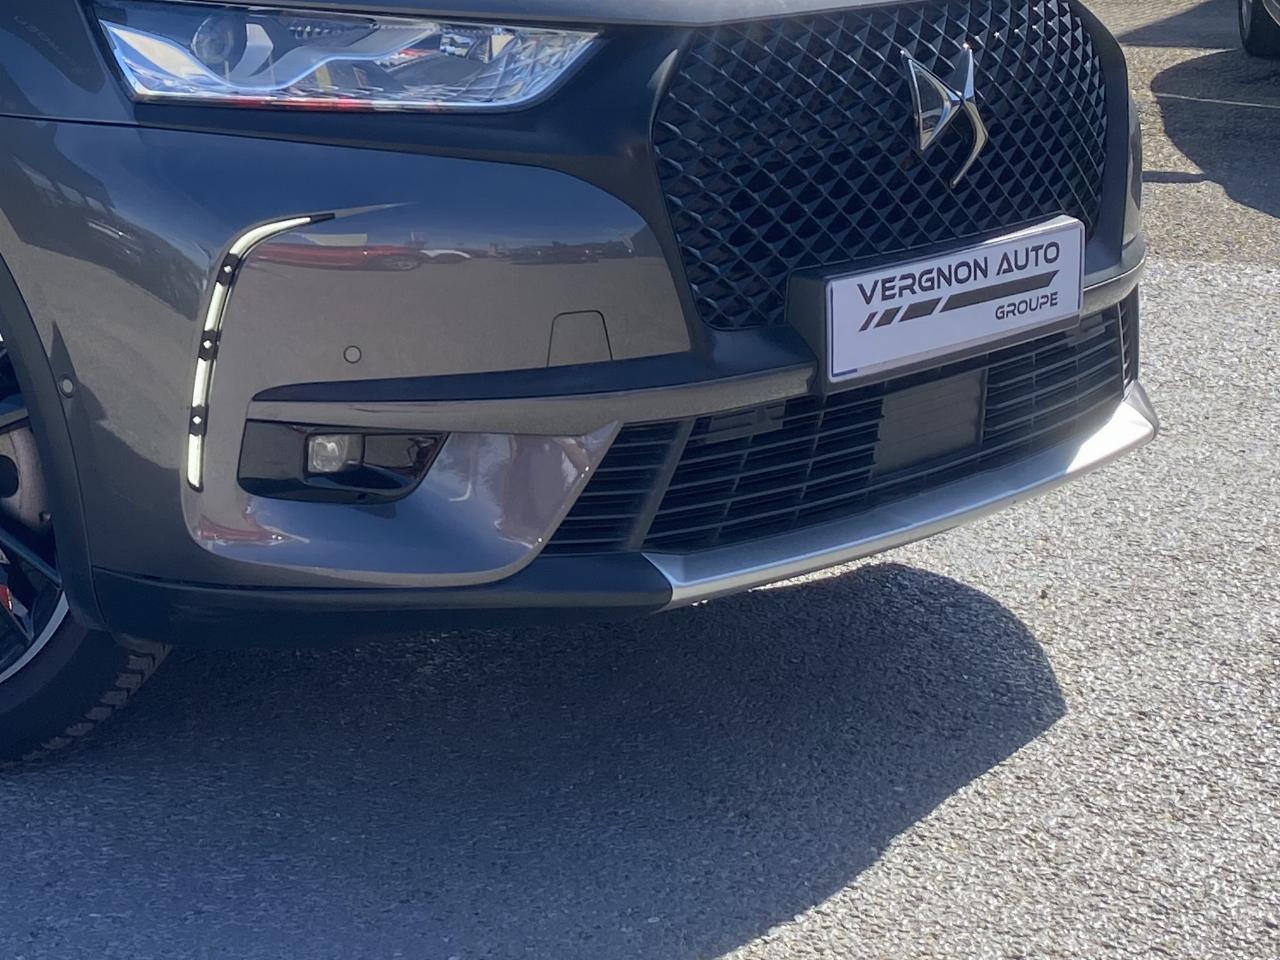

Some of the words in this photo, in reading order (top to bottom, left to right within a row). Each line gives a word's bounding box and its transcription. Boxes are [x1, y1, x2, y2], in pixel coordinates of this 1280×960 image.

[857, 256, 988, 305] VERGNON
[996, 241, 1060, 276] AUTO
[995, 291, 1059, 320] GROUPE
